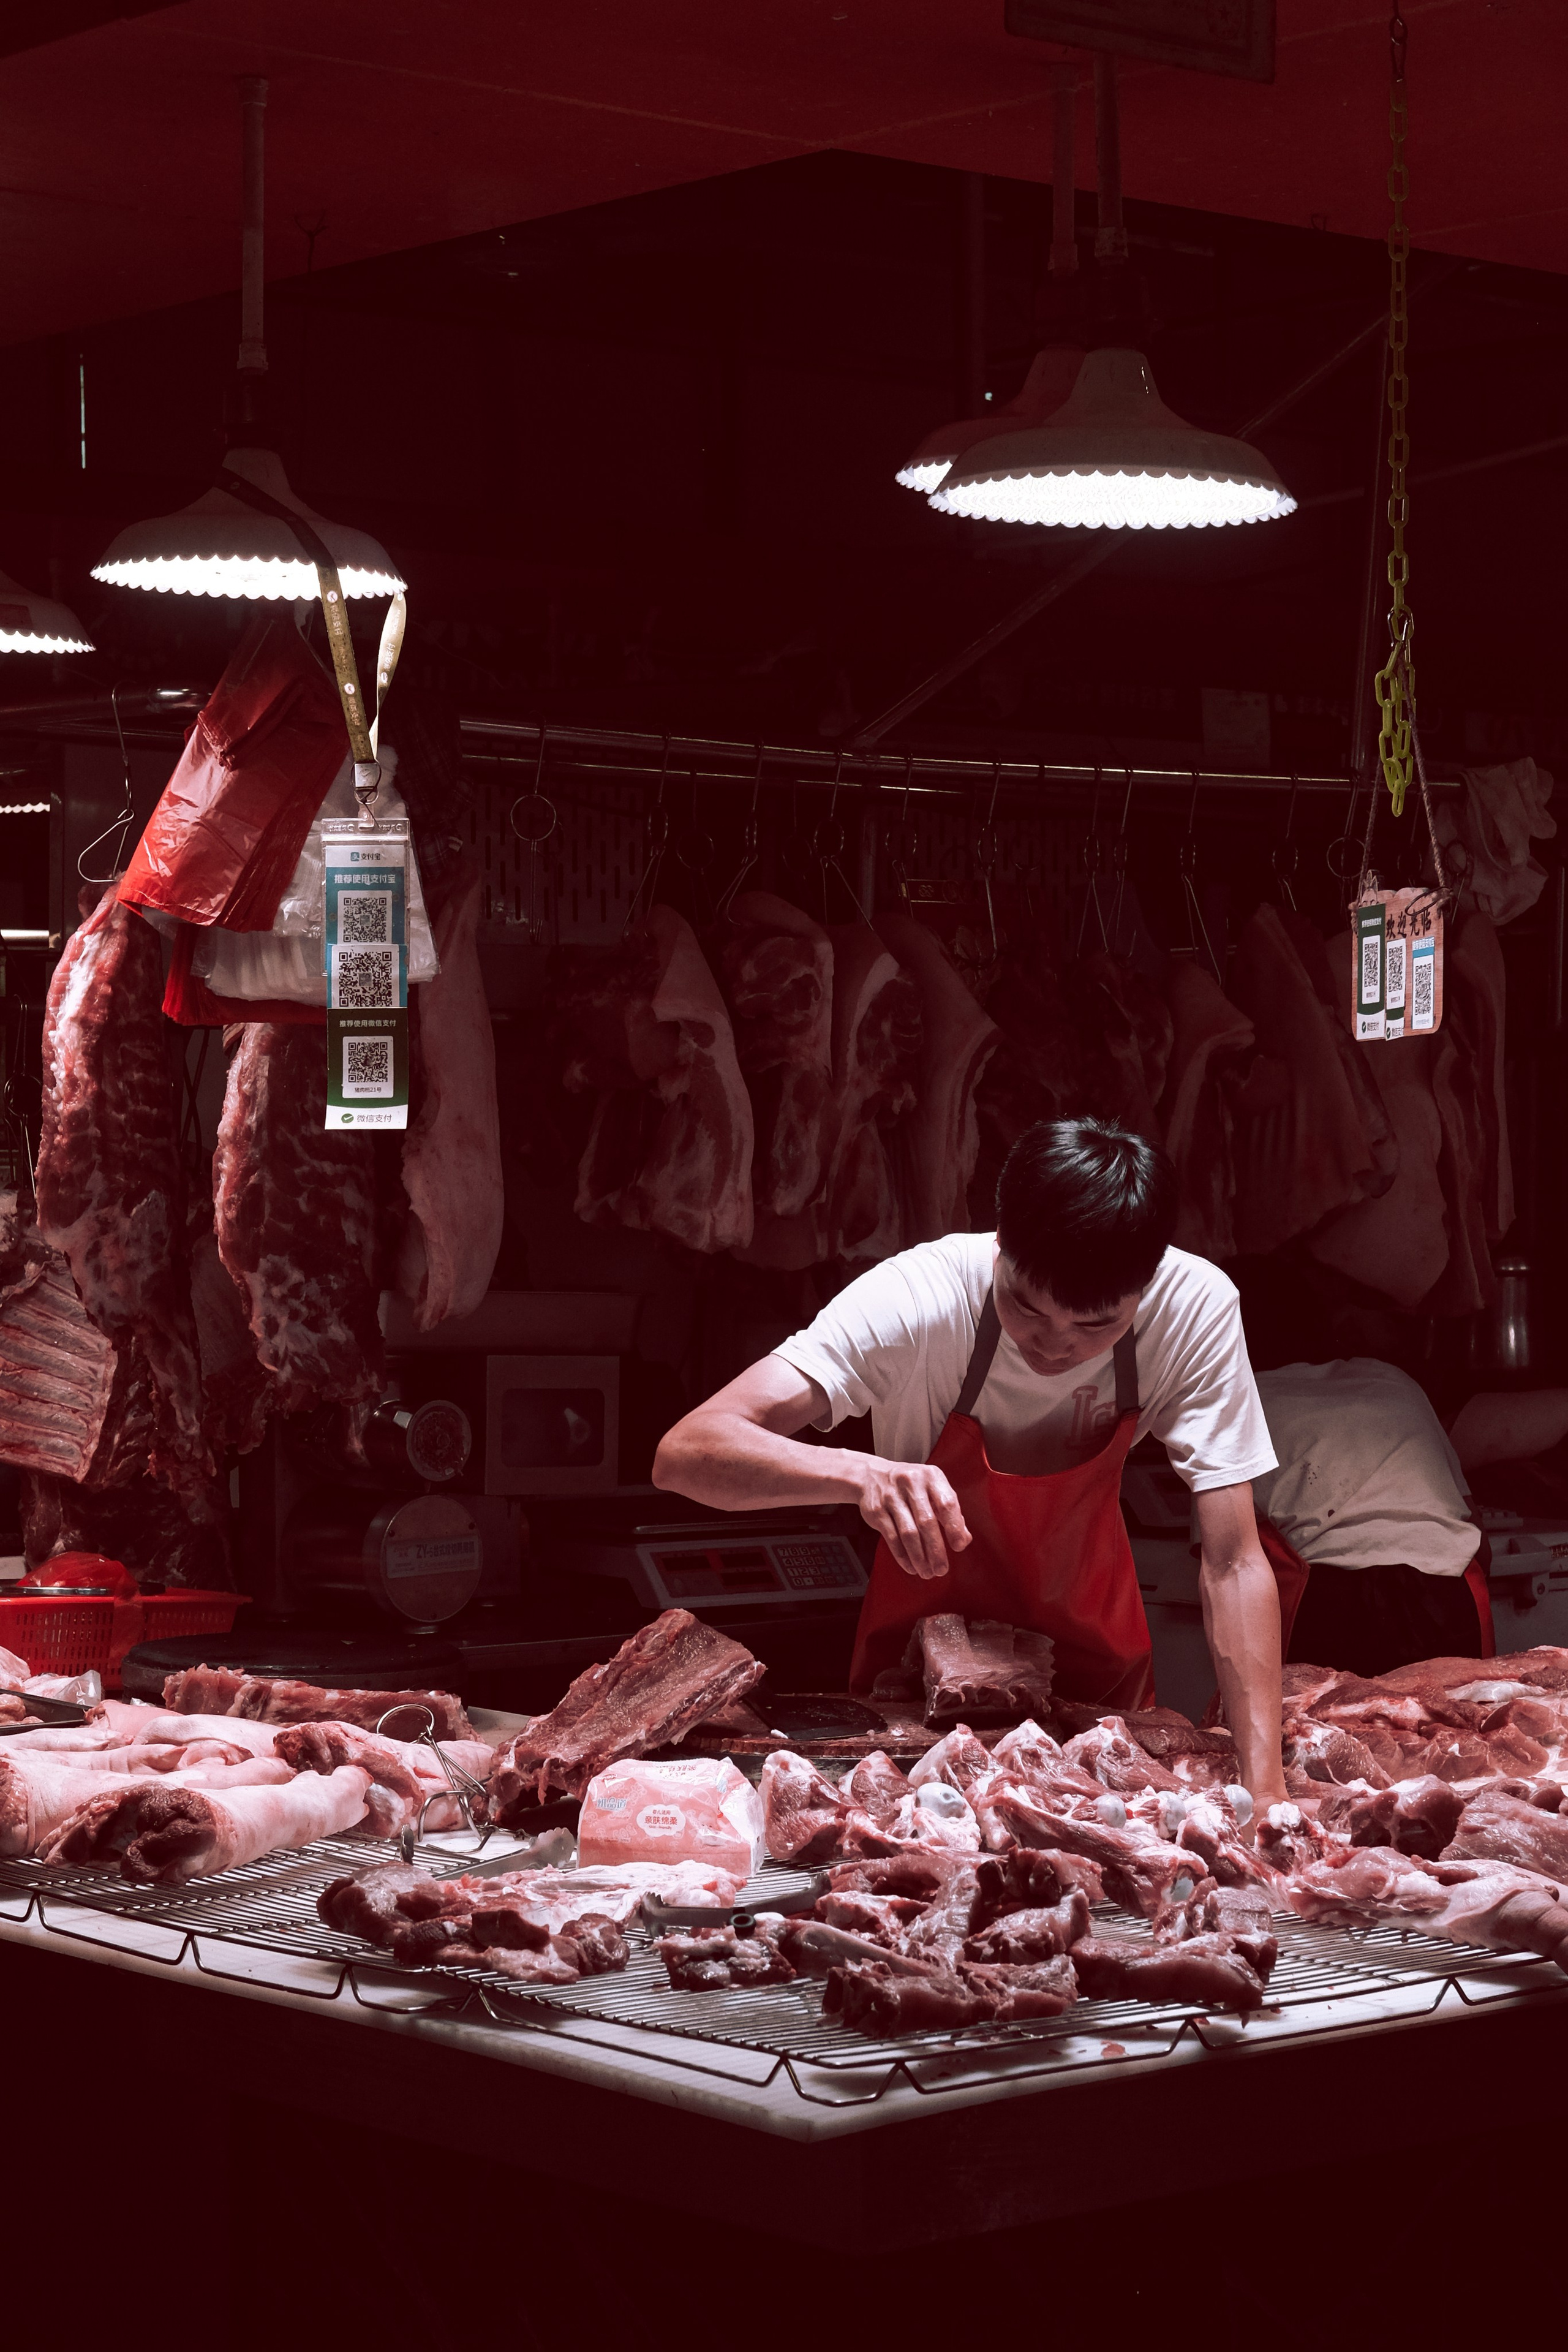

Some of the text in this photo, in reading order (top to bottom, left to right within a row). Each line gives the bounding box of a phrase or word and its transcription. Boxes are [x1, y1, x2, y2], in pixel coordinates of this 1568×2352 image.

[360, 852, 381, 861] 支付宝
[334, 874, 396, 884] 推荐使用支付宝
[1385, 909, 1432, 939] 欢迎光临
[356, 1114, 392, 1123] 微信支付
[644, 1815, 678, 1825] 亲肤绵柔
